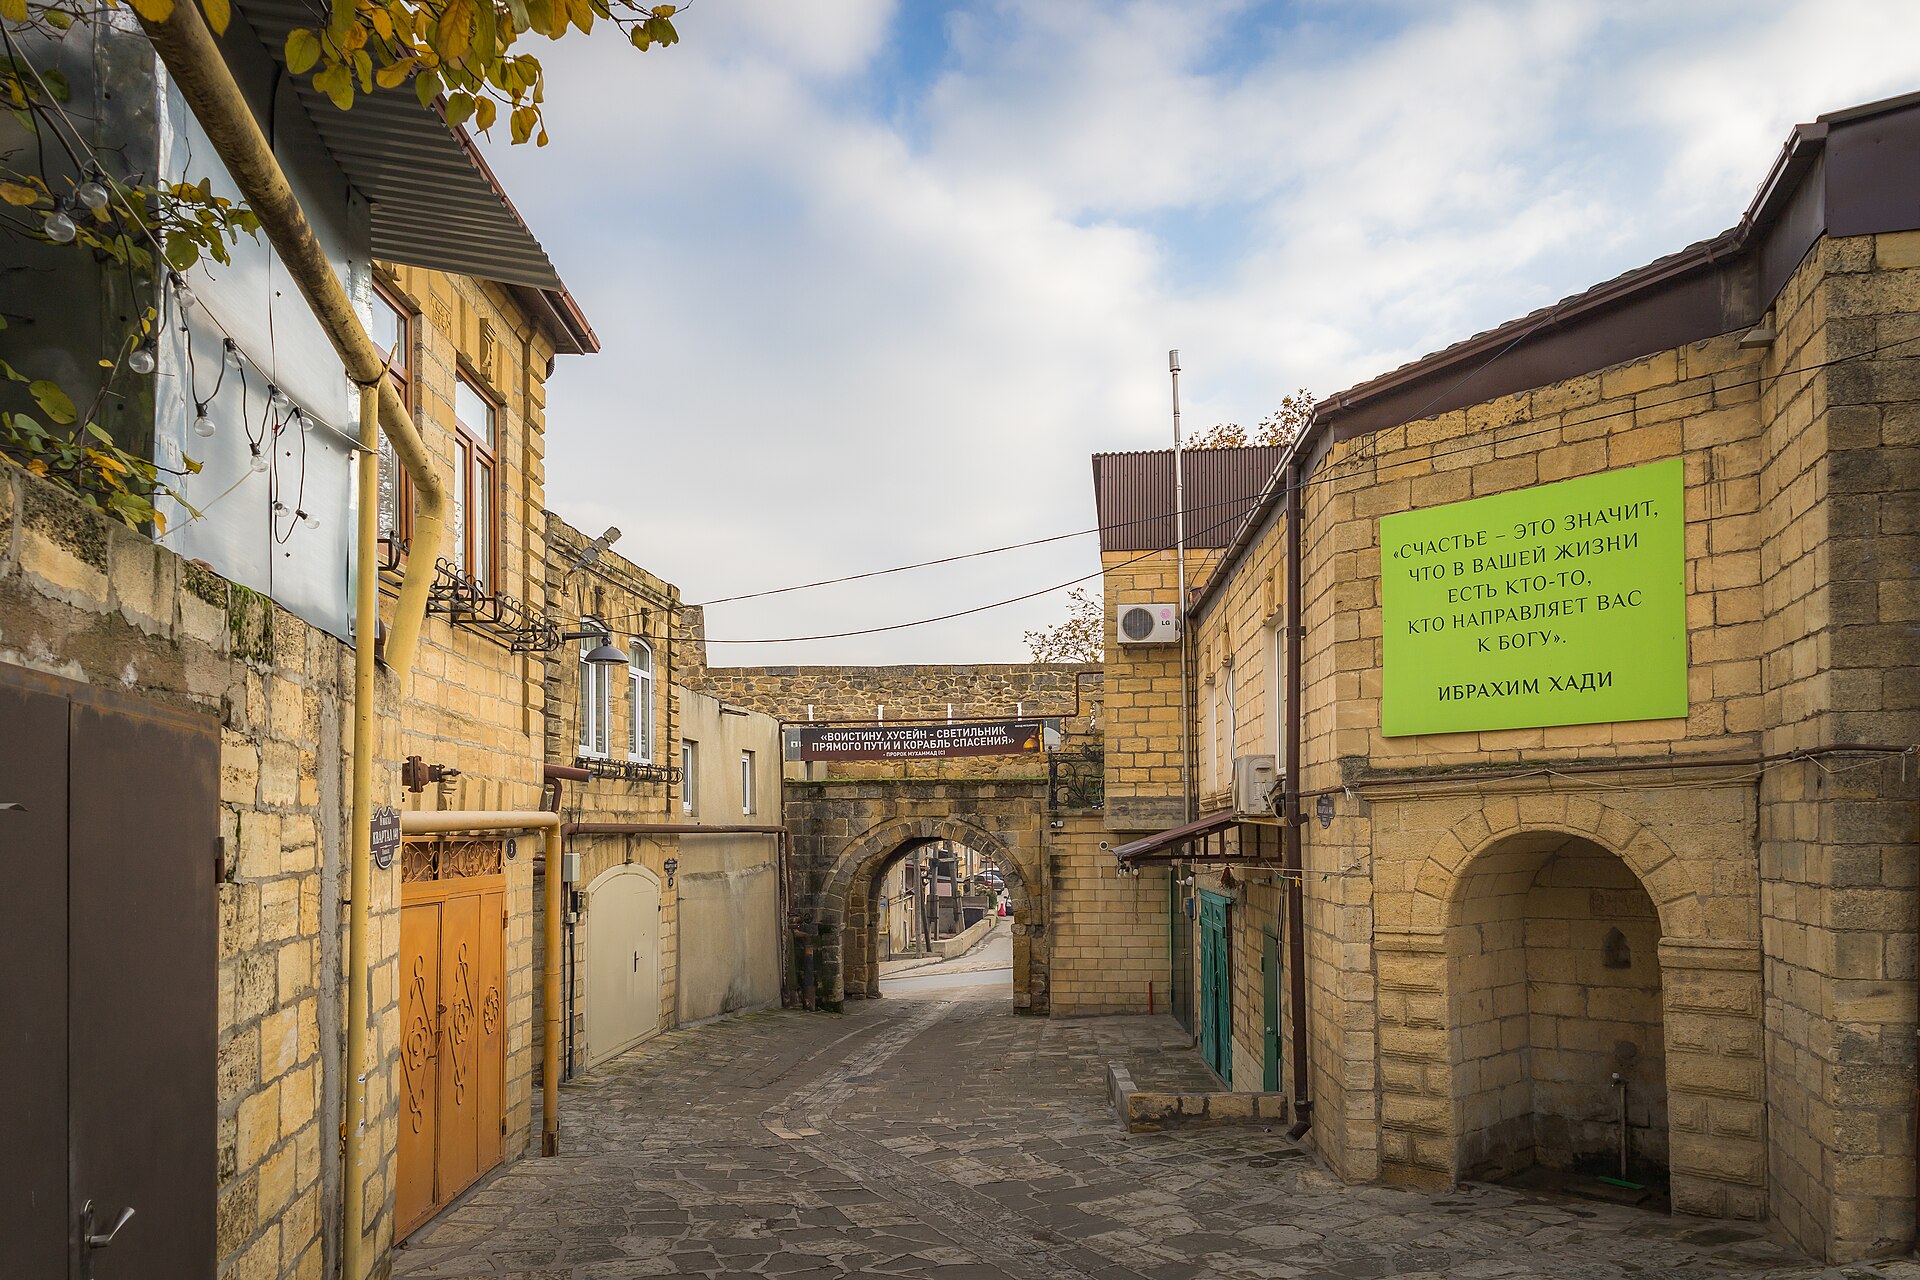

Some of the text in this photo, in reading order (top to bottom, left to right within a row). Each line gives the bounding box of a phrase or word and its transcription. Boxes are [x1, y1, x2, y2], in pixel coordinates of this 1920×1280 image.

[1393, 530, 1487, 561] «СЧАСТЬЕ
[1513, 518, 1555, 540] ЭТО
[1564, 499, 1658, 531] ЗНАЧИТ,
[1408, 532, 1638, 582] ЧТО В ВАШЕЙ ЖИЗНИ
[1447, 569, 1592, 604] ЕСТЬ КТО-ТО,
[1408, 589, 1642, 635] КТО НАПРАВЛЯЕТ ВАС
[1477, 629, 1566, 653] К БОГУ».
[1437, 671, 1612, 702] ИБРАХИМ ХАДИ
[811, 736, 1015, 752] ПРЯМОГО ПУТИ И КОРАБЛЬ СПАСЕНИЯ»
[820, 731, 885, 742] «ВОИСТИНУ,
[886, 729, 927, 740] ХУСЕЙН
[936, 726, 1007, 738] СВЕТИЛЬНИК
[372, 829, 393, 845] КВАРТАЛ
